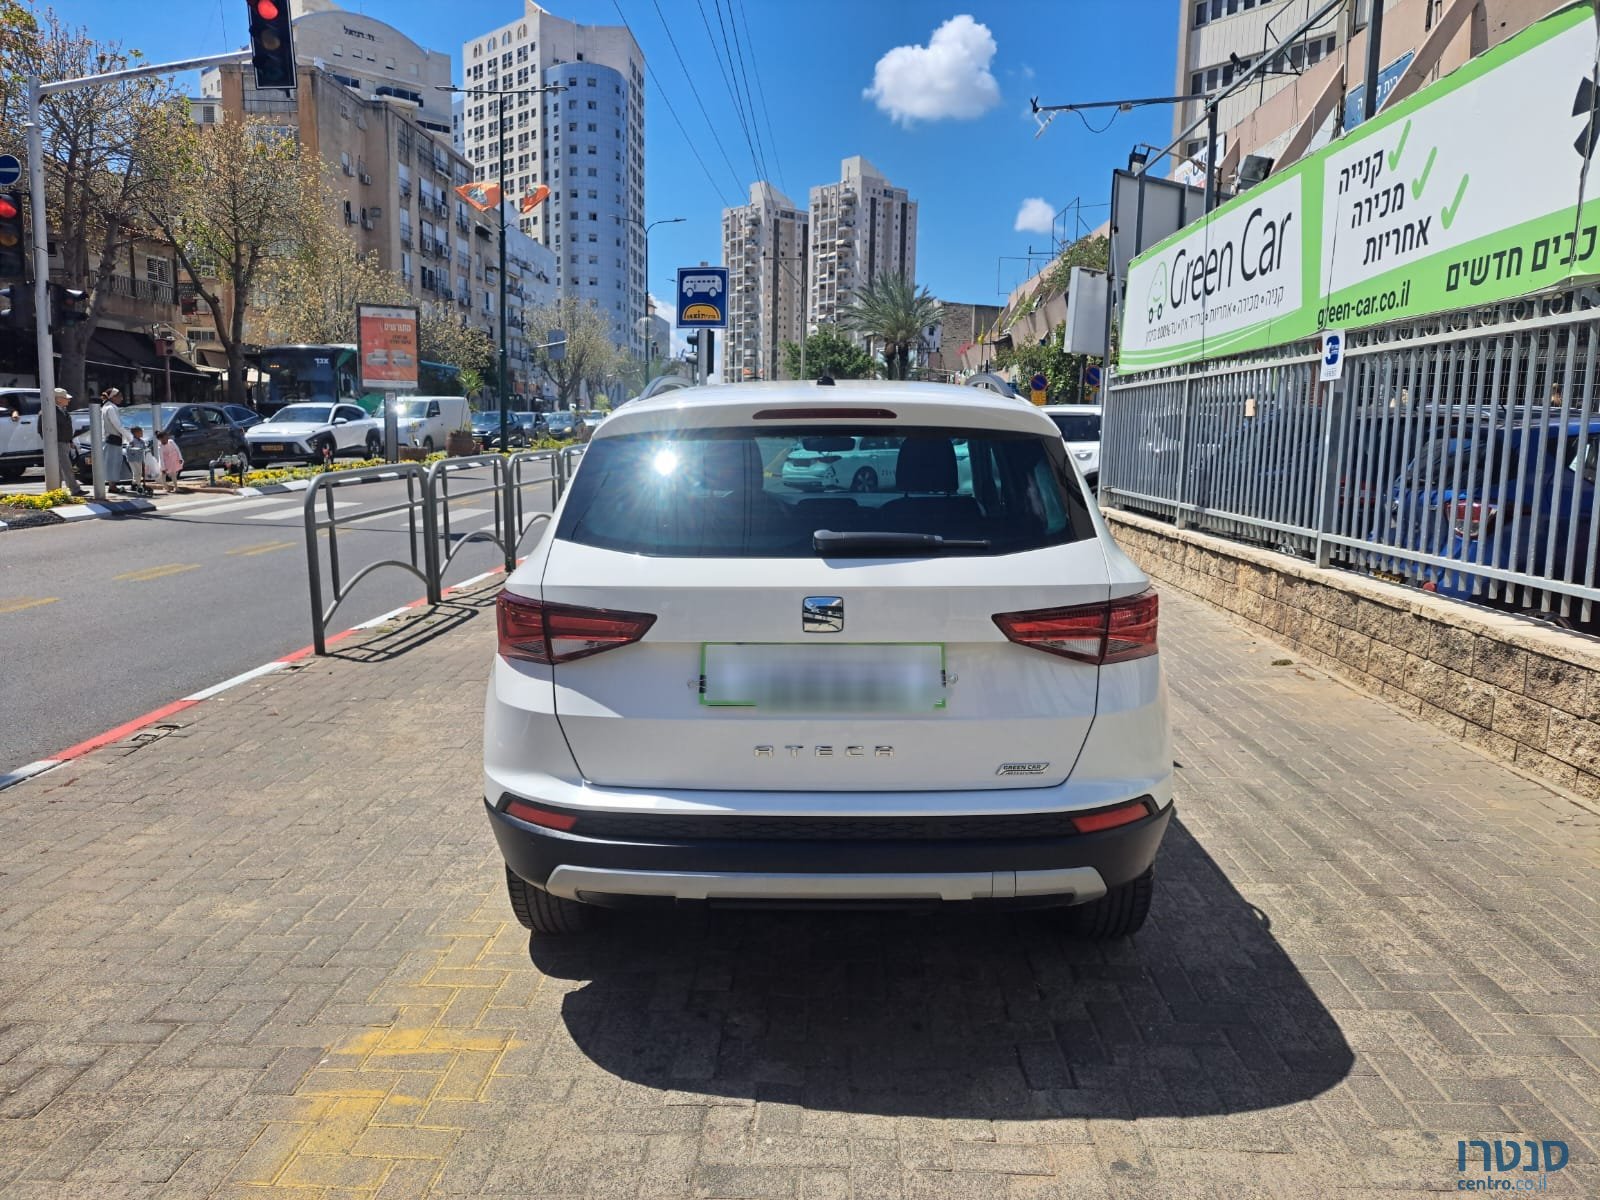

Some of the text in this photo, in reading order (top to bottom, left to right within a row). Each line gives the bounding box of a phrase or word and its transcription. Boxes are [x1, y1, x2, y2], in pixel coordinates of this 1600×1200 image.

[1339, 150, 1384, 195] קנייה
[1351, 182, 1405, 229] מכירה
[1170, 207, 1292, 309] Green Car
[1363, 215, 1432, 266] אחריות
[1445, 246, 1523, 292] חדשים
[1209, 302, 1233, 323] אחריות
[1237, 294, 1259, 314] מכירה
[1265, 286, 1284, 308] קניה
[1317, 279, 1411, 330] green-car.co.il
[753, 745, 895, 759] ATECA
